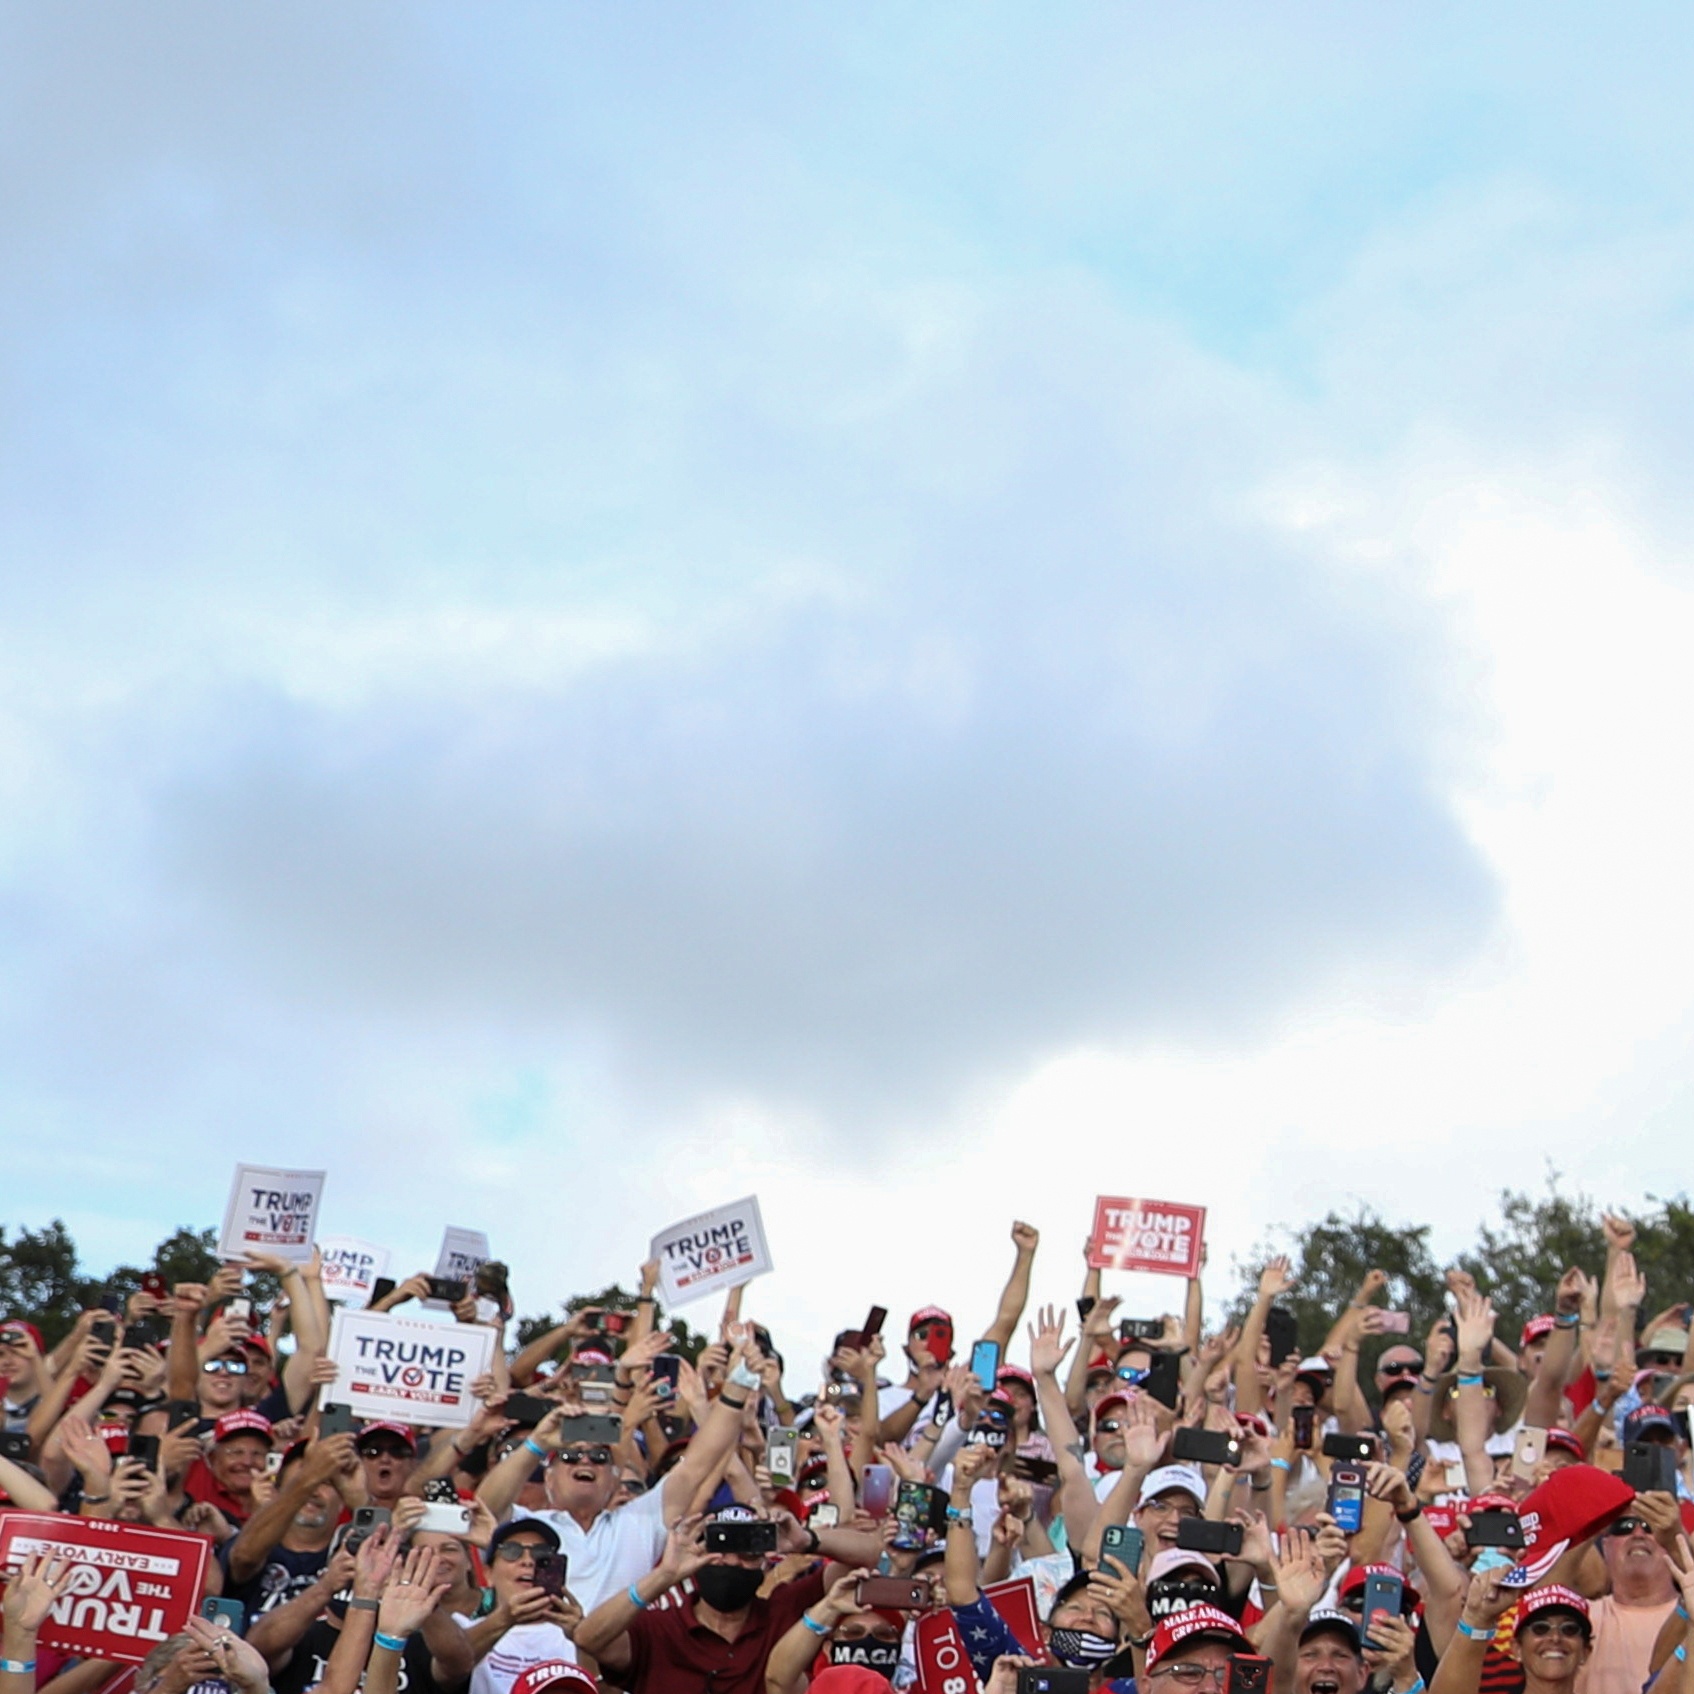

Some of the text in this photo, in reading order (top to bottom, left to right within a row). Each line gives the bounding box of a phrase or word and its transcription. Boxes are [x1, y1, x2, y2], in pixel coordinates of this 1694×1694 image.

[252, 1189, 312, 1212] TRUMP
[270, 1213, 310, 1234] VOTE
[1105, 1208, 1191, 1233] TRUMP
[663, 1219, 744, 1259] TRUMP
[323, 1249, 374, 1267] UMP
[689, 1236, 751, 1269] VOTE
[321, 1261, 372, 1282] OTE
[355, 1336, 465, 1367] TRUMP
[381, 1363, 465, 1393] VOTE
[968, 1430, 1005, 1444] AGA
[93, 1550, 150, 1569] EARLY
[135, 1582, 172, 1599] THE
[50, 1595, 169, 1641] TRUM
[1164, 1610, 1197, 1630] MAKE
[835, 1646, 896, 1664] MAGA
[933, 1627, 959, 1669] TO
